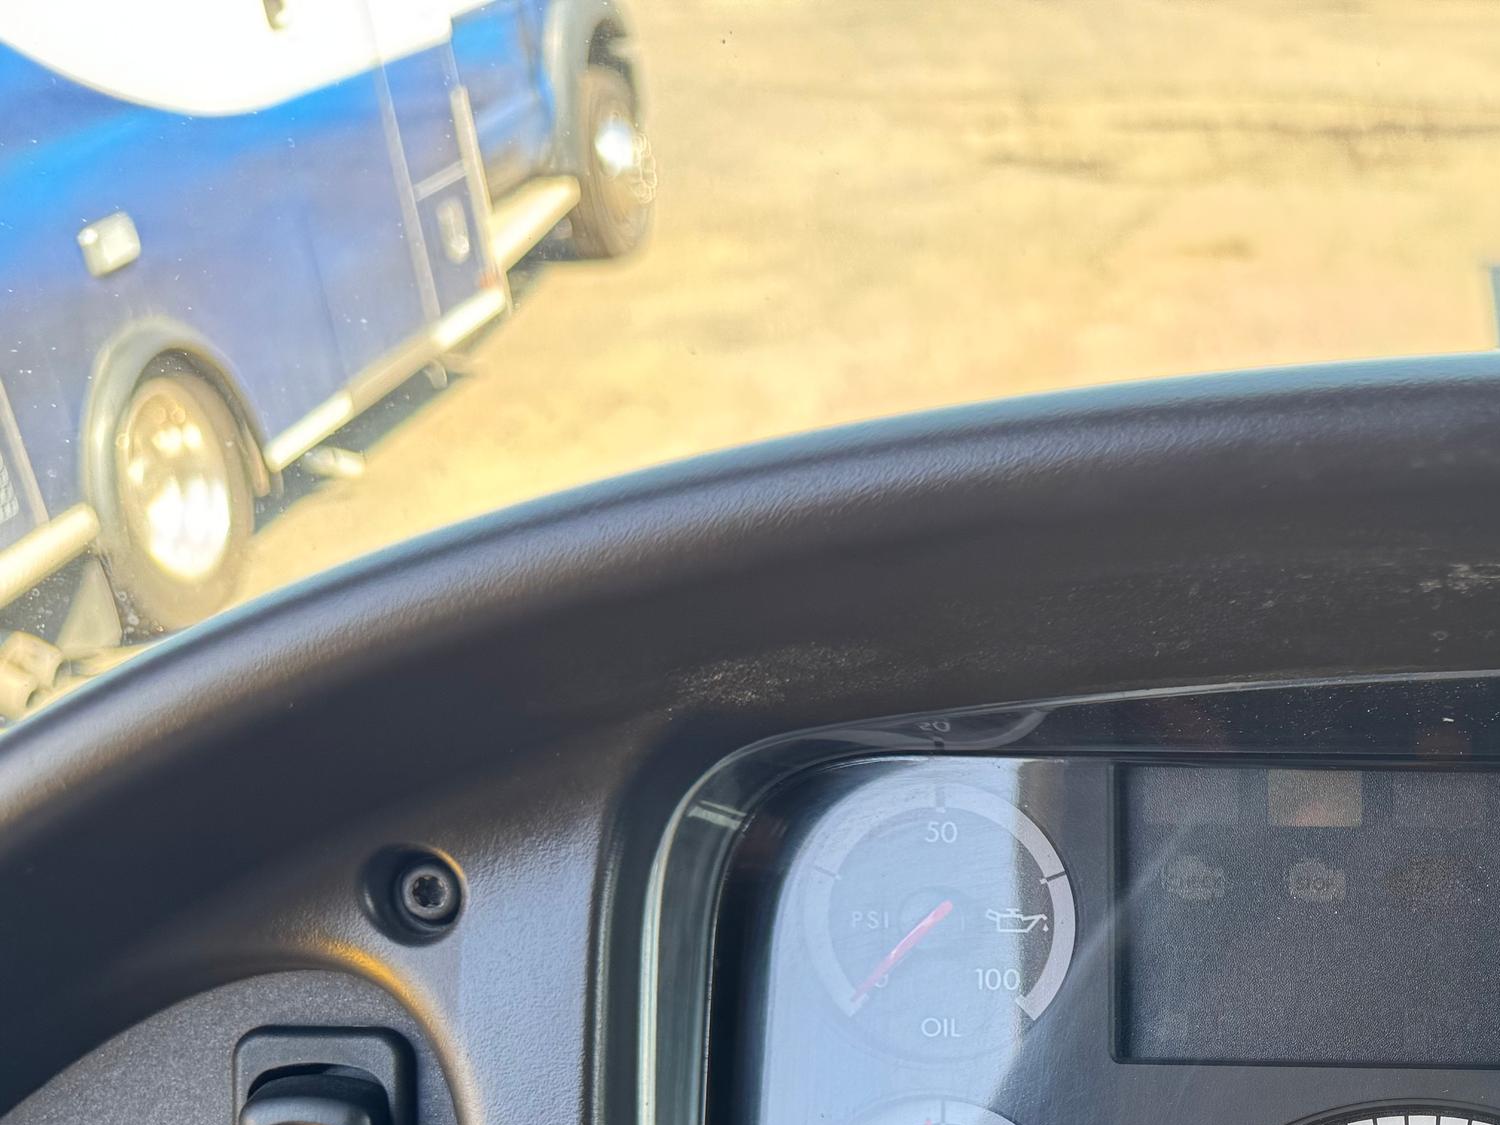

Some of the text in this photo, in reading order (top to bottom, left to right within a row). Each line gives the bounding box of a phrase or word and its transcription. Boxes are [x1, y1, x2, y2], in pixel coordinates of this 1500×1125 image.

[925, 822, 957, 843] 50
[851, 911, 889, 929] PSI
[976, 969, 1021, 991] 100
[921, 1018, 961, 1037] OIL
